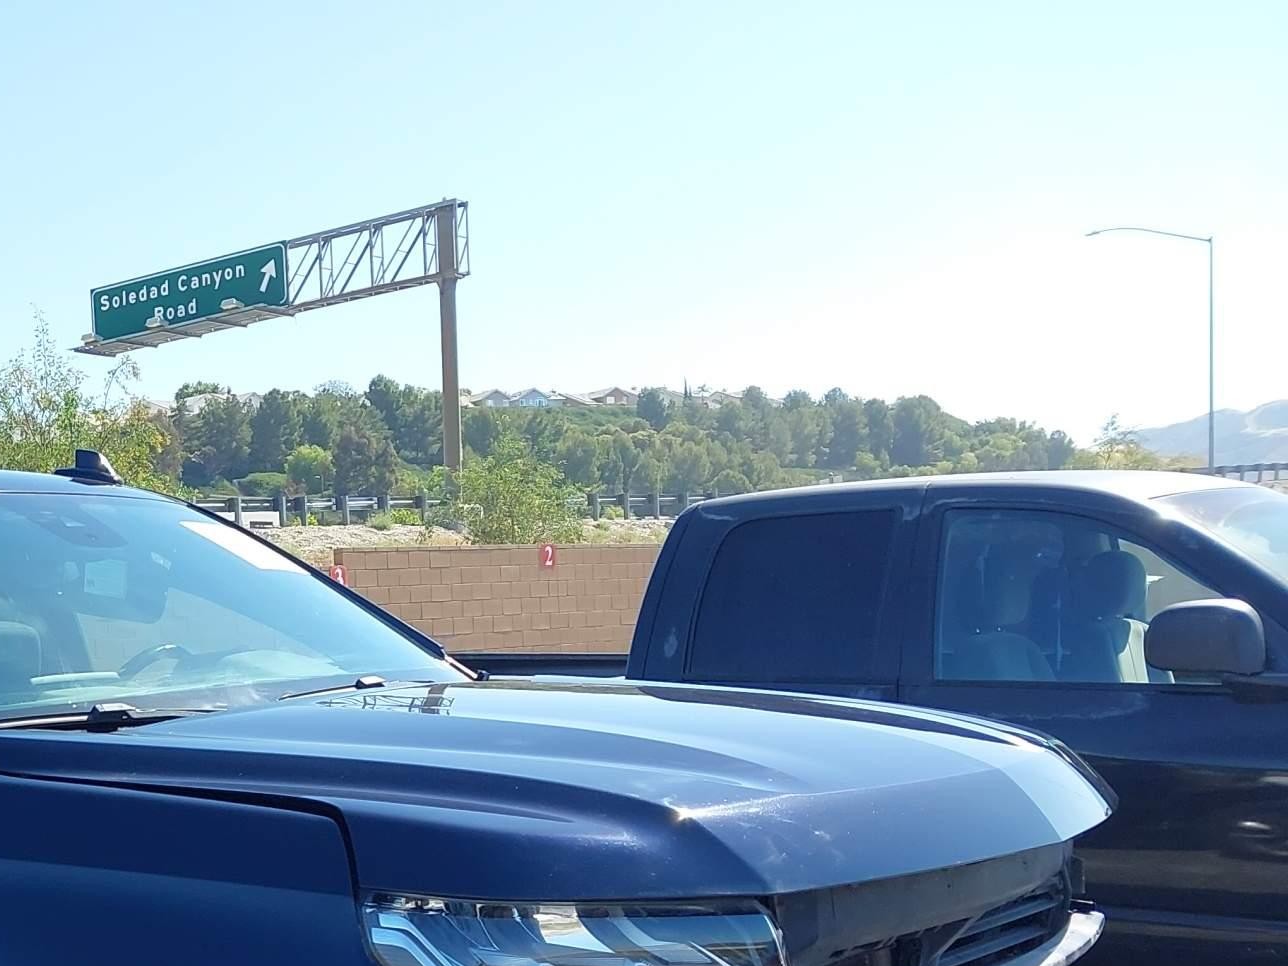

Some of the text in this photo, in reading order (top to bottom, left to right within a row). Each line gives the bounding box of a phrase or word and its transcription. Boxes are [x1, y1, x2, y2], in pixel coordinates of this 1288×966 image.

[100, 264, 246, 312] Soledad Canyon
[154, 298, 197, 320] Road
[544, 545, 553, 566] 2
